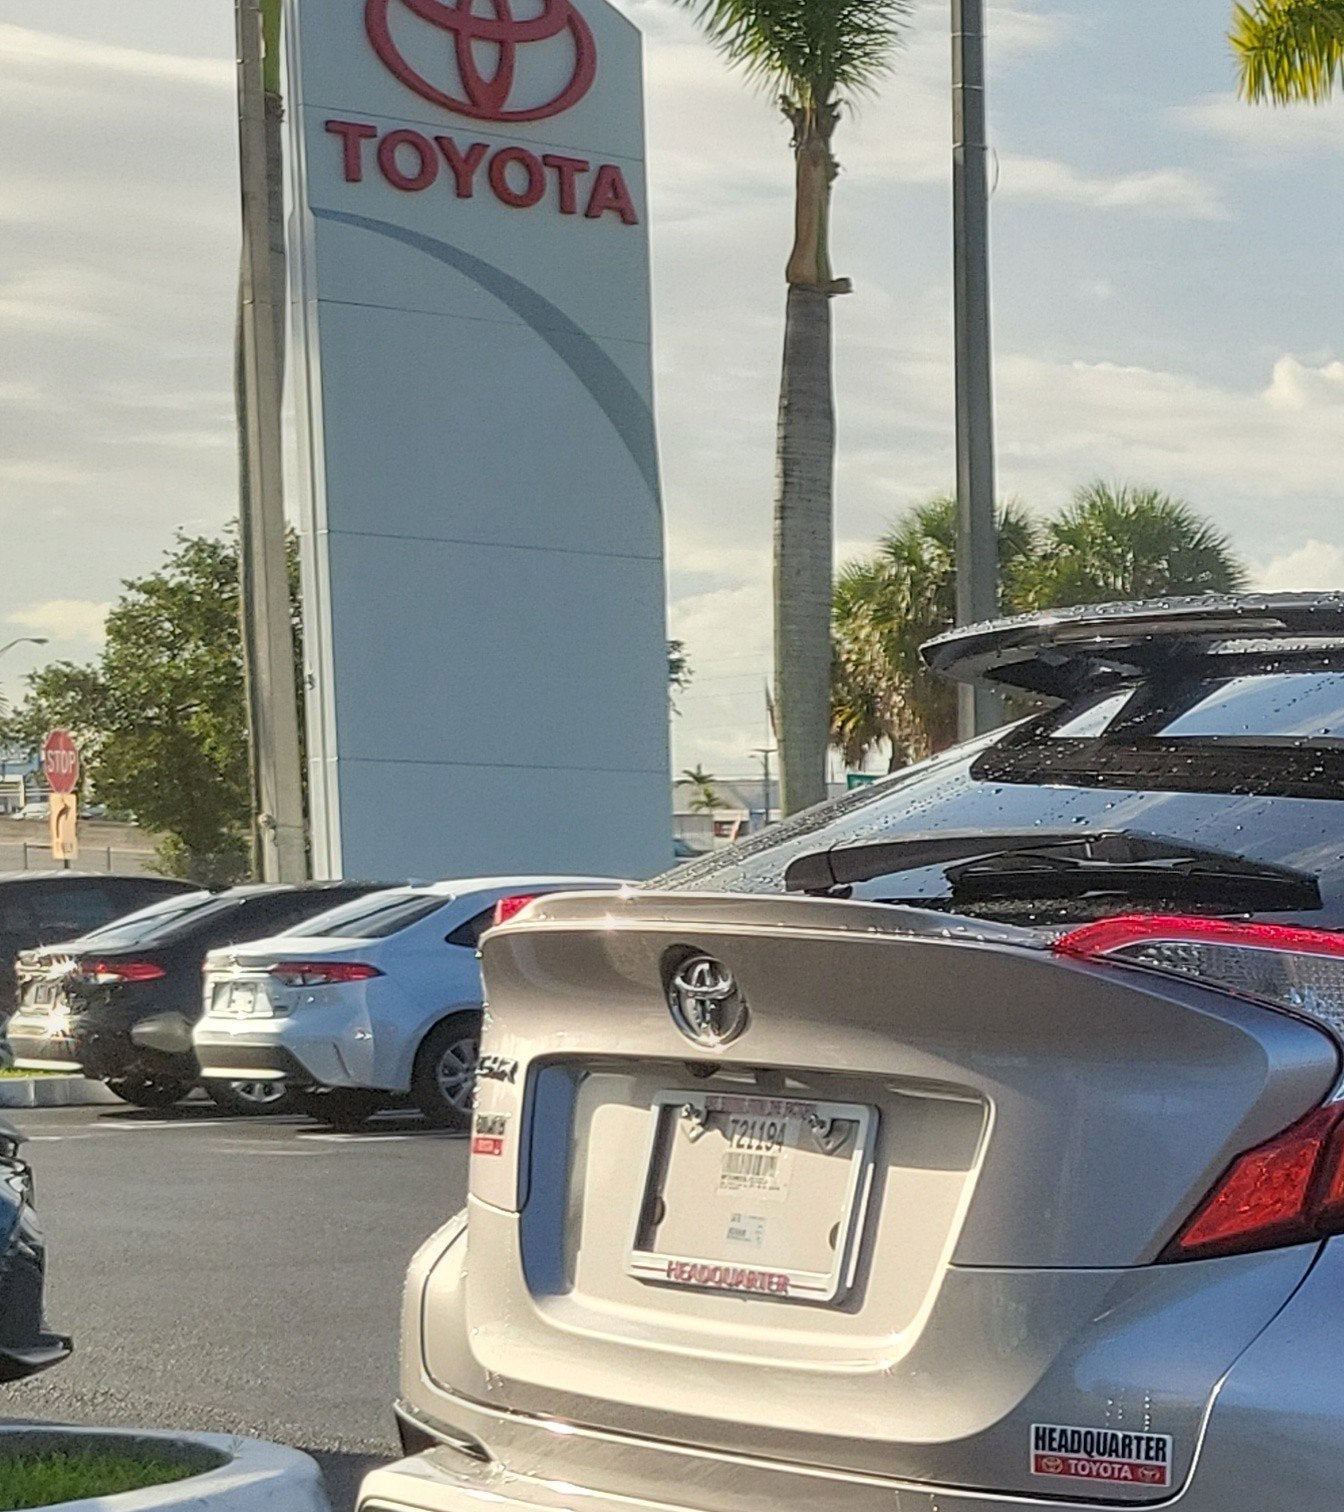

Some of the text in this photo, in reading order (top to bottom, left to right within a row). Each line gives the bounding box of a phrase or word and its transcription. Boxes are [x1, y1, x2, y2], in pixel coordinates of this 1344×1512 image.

[325, 119, 639, 226] TOYOTA
[47, 750, 76, 773] STOP
[729, 1118, 787, 1153] 721194
[666, 1260, 790, 1295] HEADQUARTER
[1034, 1426, 1168, 1463] HEADQUARTER
[1068, 1461, 1132, 1480] TOYOTA
